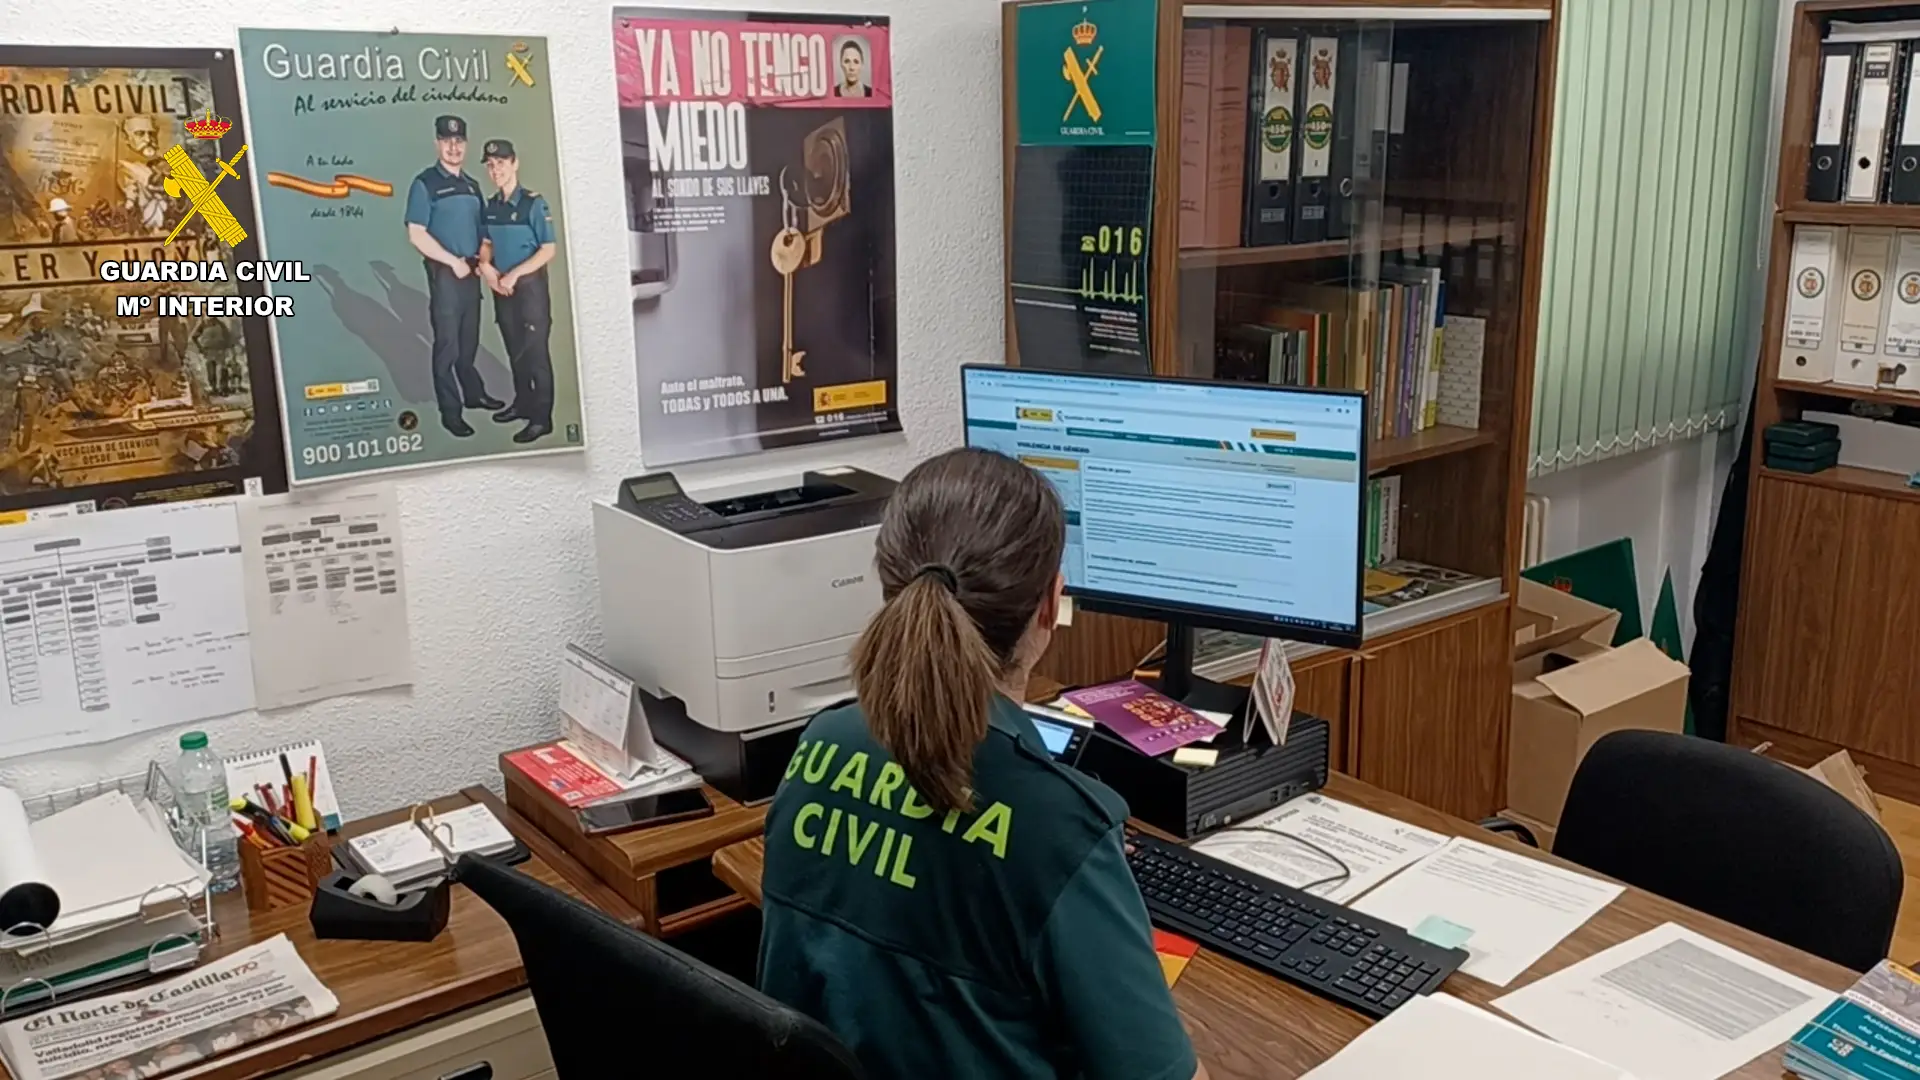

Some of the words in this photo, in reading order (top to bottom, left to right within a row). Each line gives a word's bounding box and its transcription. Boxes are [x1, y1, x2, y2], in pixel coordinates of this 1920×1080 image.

[262, 43, 405, 81] Guardia
[418, 46, 491, 81] Civil
[635, 28, 681, 97] YA
[691, 29, 732, 97] NO
[740, 31, 828, 98] TENGO
[94, 83, 176, 114] CIVIL
[294, 95, 315, 116] Al
[321, 87, 387, 111] servicio
[391, 84, 417, 105] del
[422, 85, 509, 106] ciudadano
[645, 100, 748, 172] MIEDO
[306, 154, 315, 168] A
[652, 178, 665, 198] AL
[702, 177, 714, 197] DE
[717, 176, 735, 196] SUS
[737, 175, 770, 196] LLAVES
[310, 206, 338, 219] desde
[1099, 225, 1143, 256] 016
[83, 250, 99, 277] Y
[660, 381, 685, 395] Ante
[687, 380, 698, 393] el
[661, 397, 702, 414] TODAS
[703, 396, 710, 411] y
[712, 391, 751, 407] TODOS
[752, 391, 761, 404] A
[763, 386, 789, 403] UNA.
[826, 412, 845, 424] 016
[82, 453, 112, 465] DESDE
[302, 442, 342, 466] 900
[346, 438, 383, 461] 101
[386, 433, 423, 456] 062
[831, 575, 864, 589] Canon
[793, 801, 917, 890] CIVIL
[23, 1014, 55, 1032] El
[58, 1004, 119, 1024] Norte
[121, 999, 149, 1010] de
[148, 970, 233, 1003] Castilla
[34, 1037, 102, 1058] Valladolid
